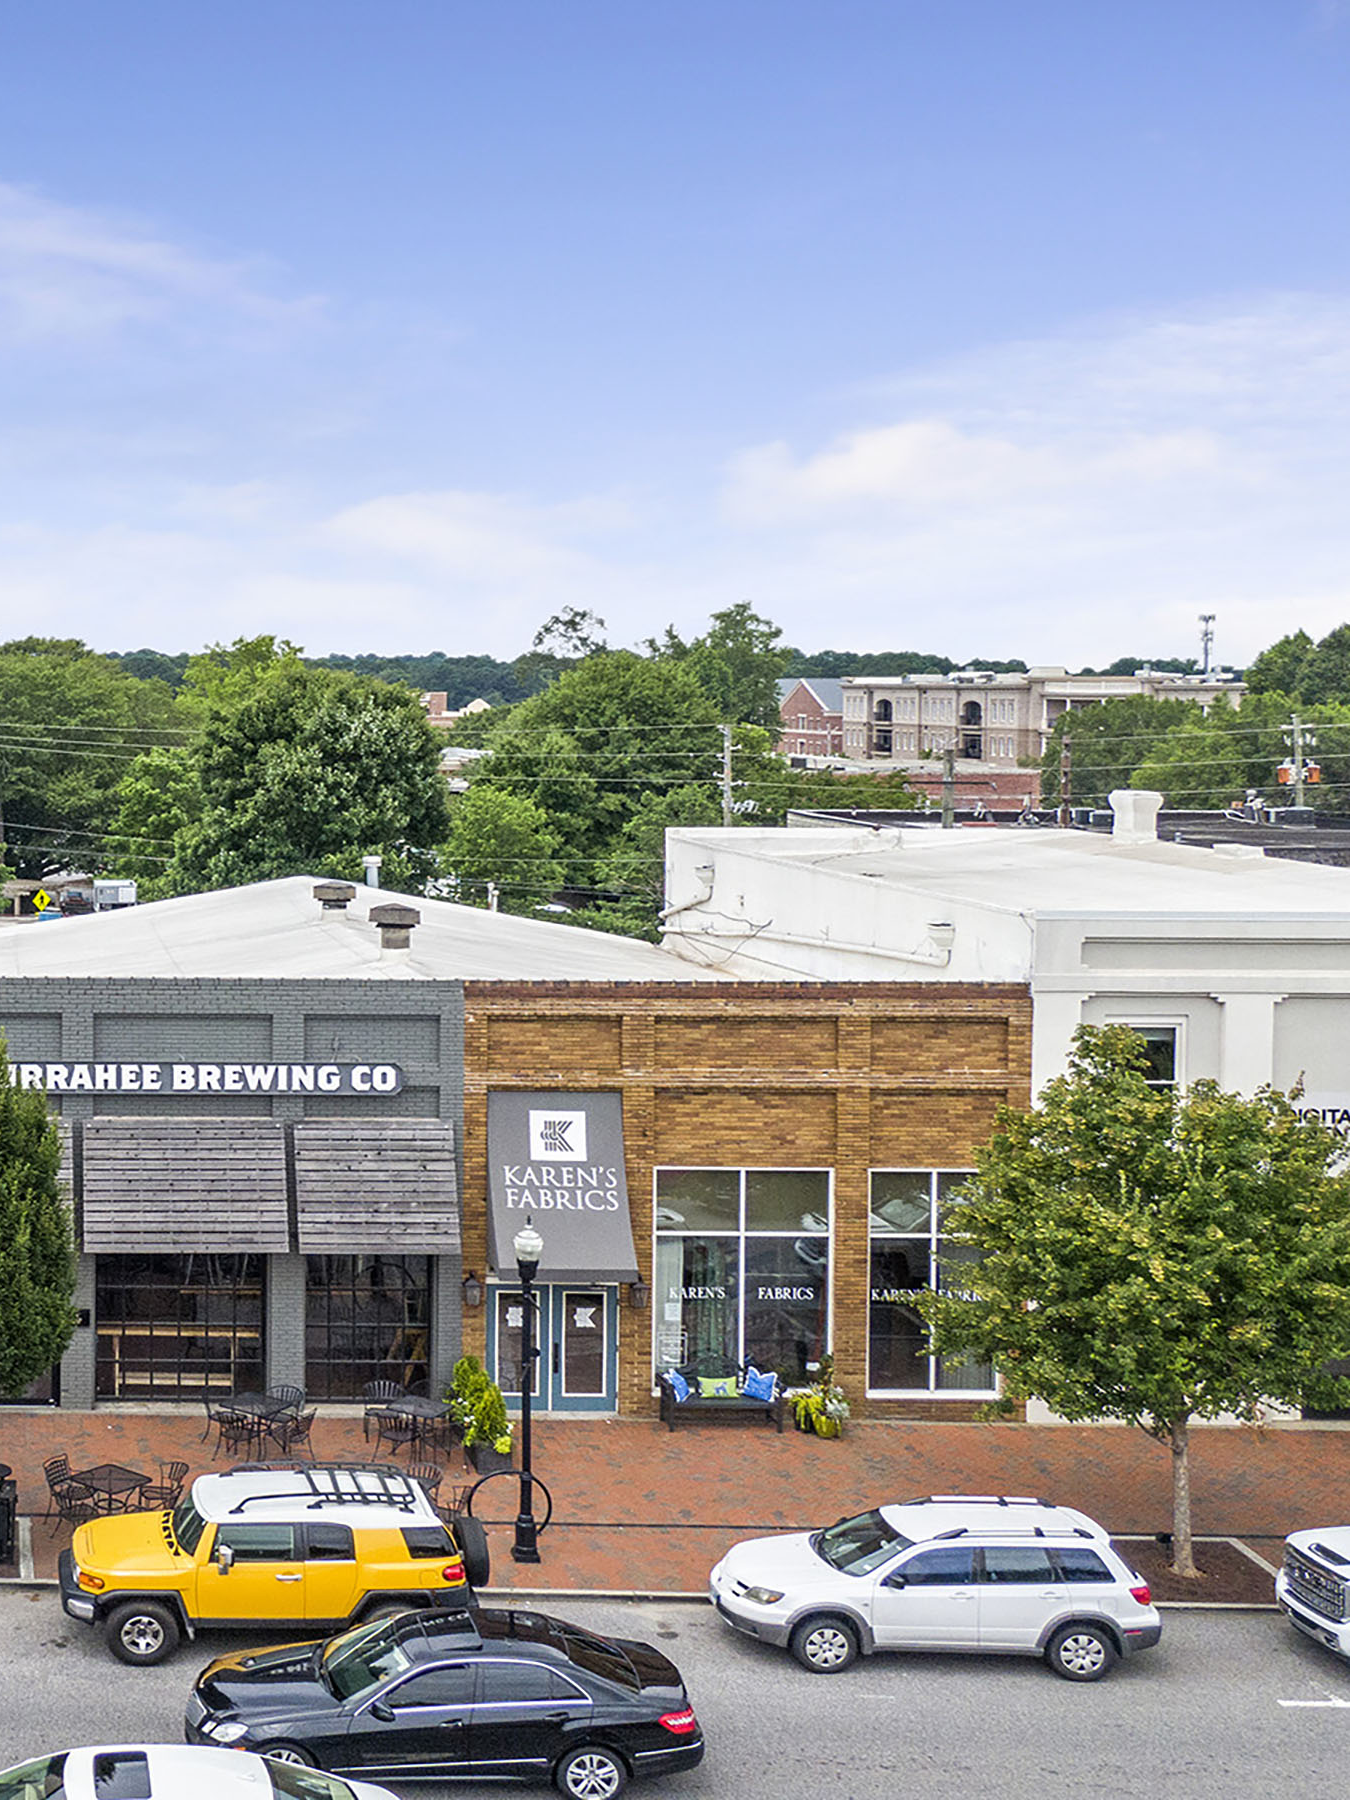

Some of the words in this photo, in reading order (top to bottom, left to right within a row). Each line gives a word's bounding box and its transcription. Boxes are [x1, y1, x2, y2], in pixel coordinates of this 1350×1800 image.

[172, 1063, 341, 1091] BREWING
[351, 1064, 397, 1091] CO
[503, 1165, 618, 1188] KAREN'S
[505, 1188, 619, 1211] FABRICS
[669, 1286, 727, 1300] KAREN'S
[757, 1287, 815, 1300] FABRICS
